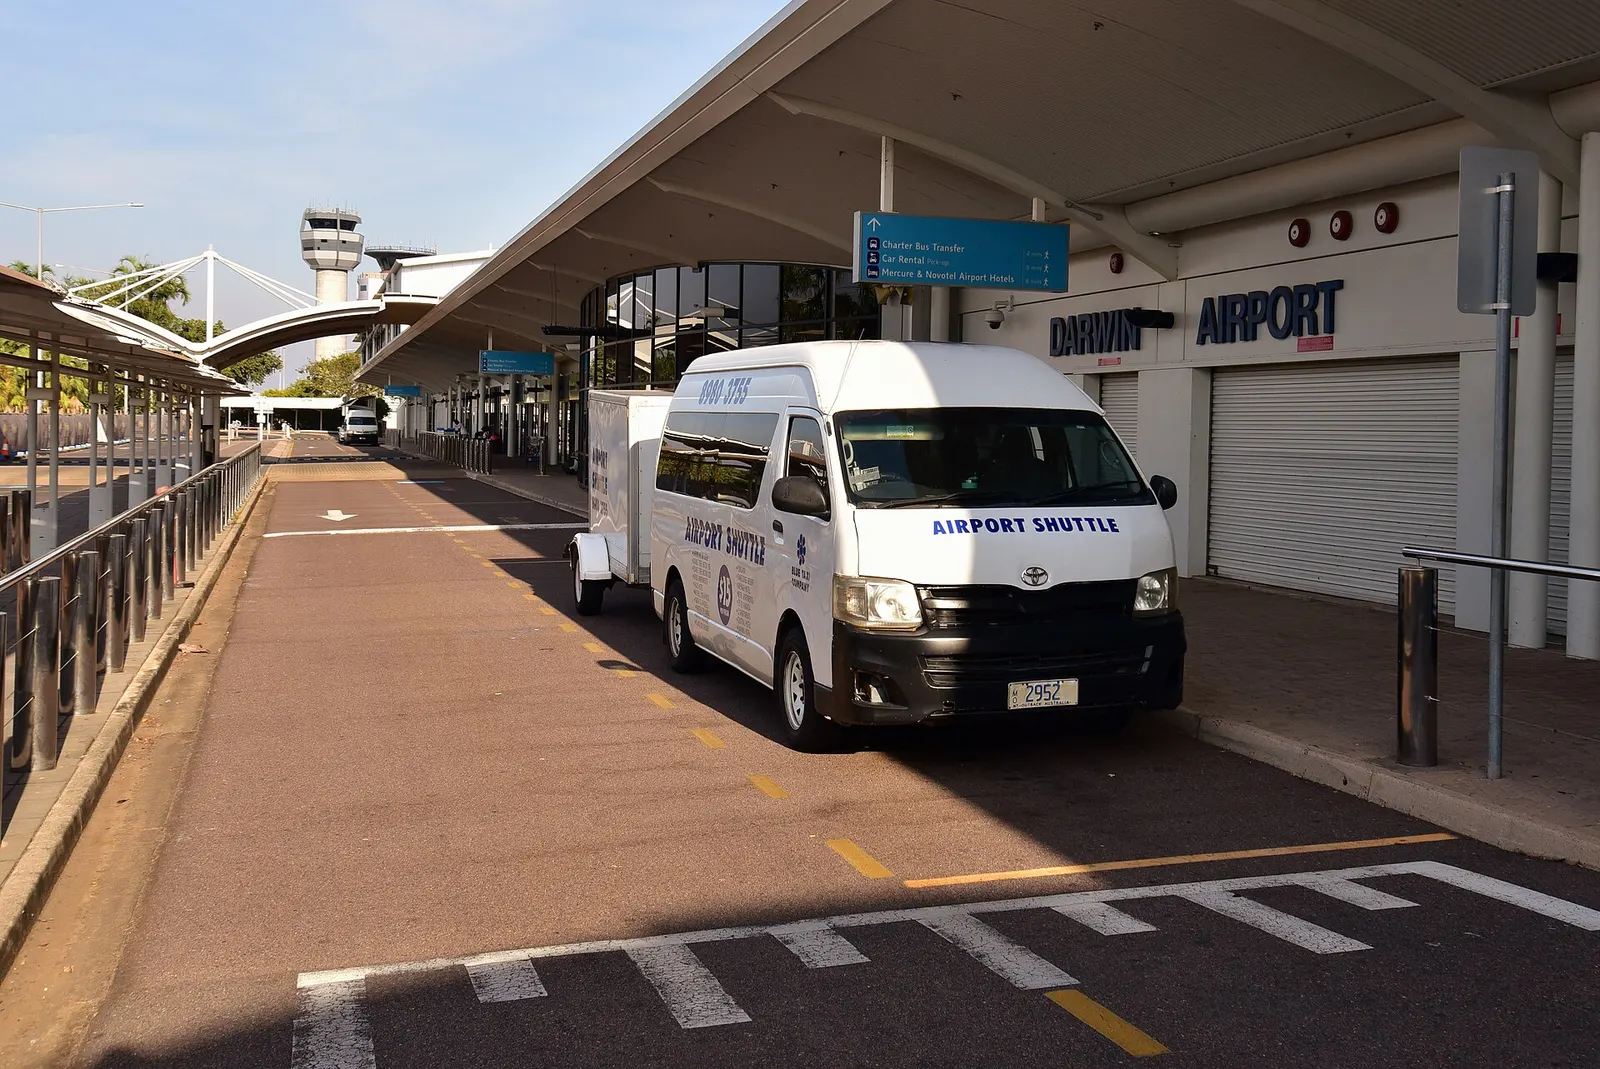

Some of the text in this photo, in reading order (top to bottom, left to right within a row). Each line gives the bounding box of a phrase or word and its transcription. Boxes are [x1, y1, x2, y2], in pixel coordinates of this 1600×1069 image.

[882, 240, 965, 253] Charter Bus Transfer
[882, 254, 950, 267] Car Rental Pick-up
[881, 268, 1015, 283] Mercure & Novotel Airport Hotels
[1049, 279, 1344, 357] DARWIN AIRPORT
[699, 377, 752, 404] 8980 3755
[933, 517, 1120, 535] AIRPORT SHUTTLE
[685, 516, 765, 565] AIRPORT SHUTTLE
[1026, 684, 1060, 702] 2952
